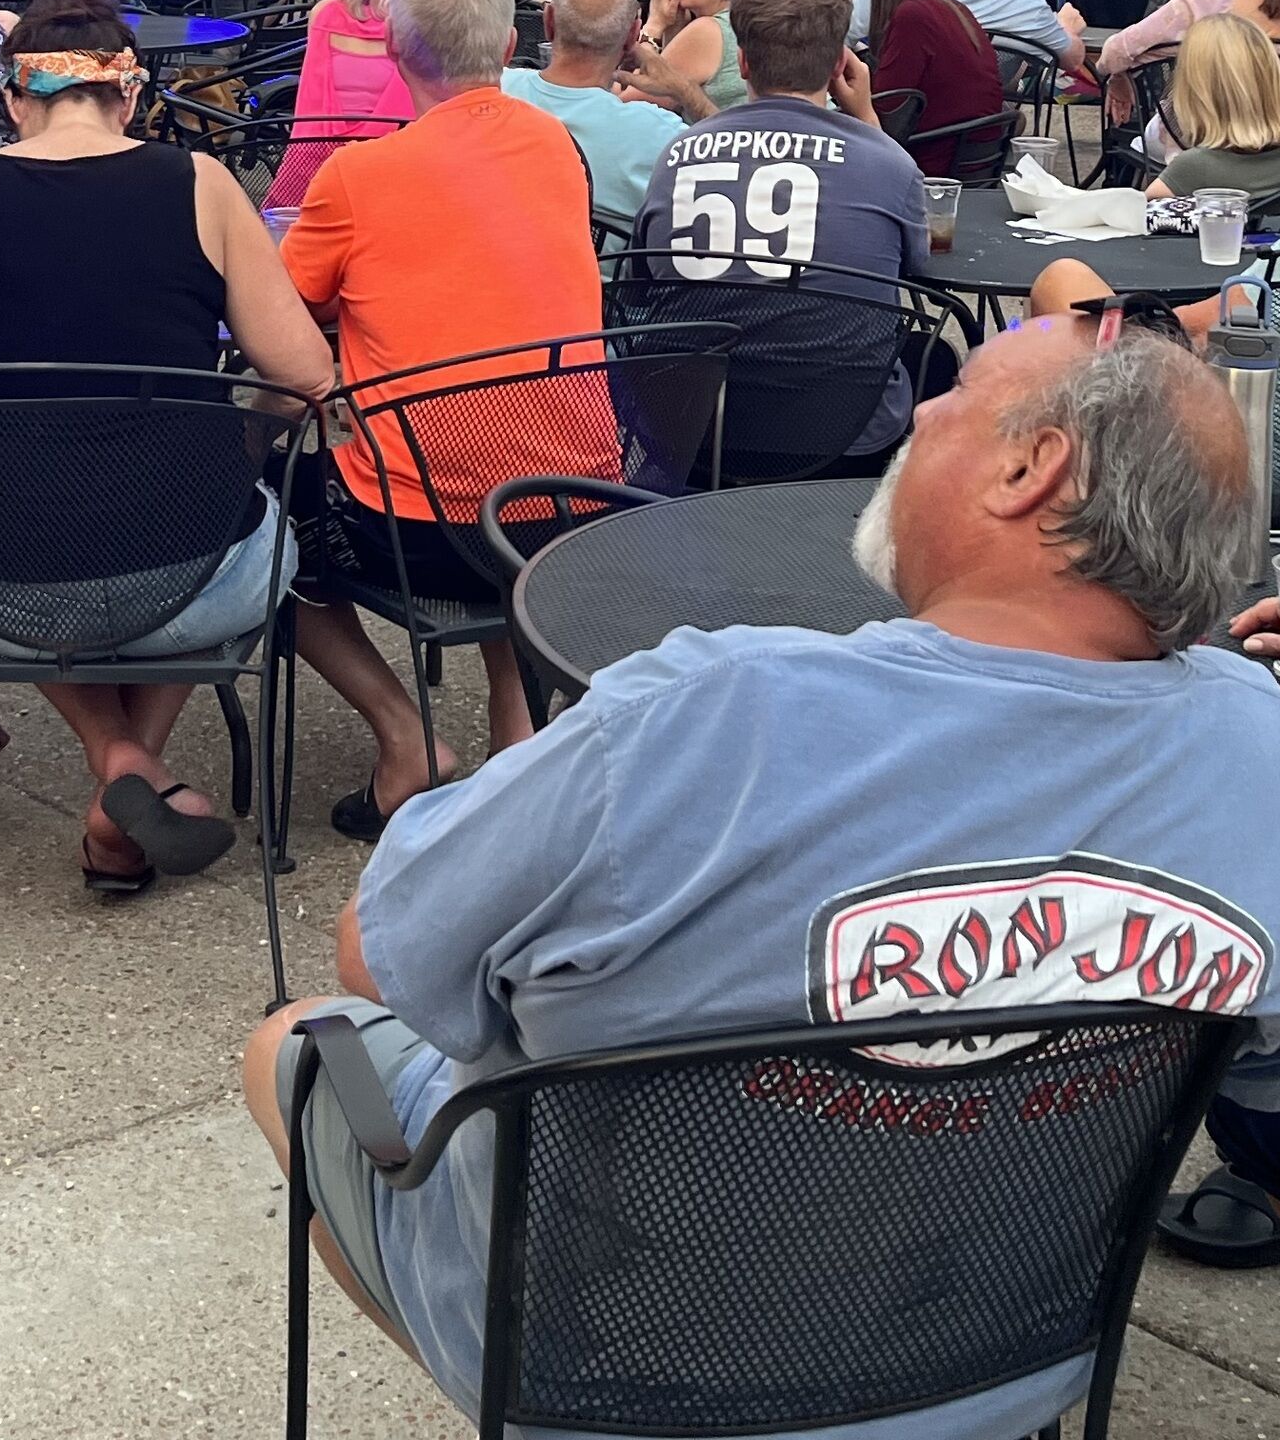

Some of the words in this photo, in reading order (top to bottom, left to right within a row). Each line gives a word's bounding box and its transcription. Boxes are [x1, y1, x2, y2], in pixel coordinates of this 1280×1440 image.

[666, 130, 847, 168] STOPPKOTTE
[670, 161, 820, 281] 59
[849, 895, 1066, 1006] RON
[1071, 908, 1258, 1011] JON
